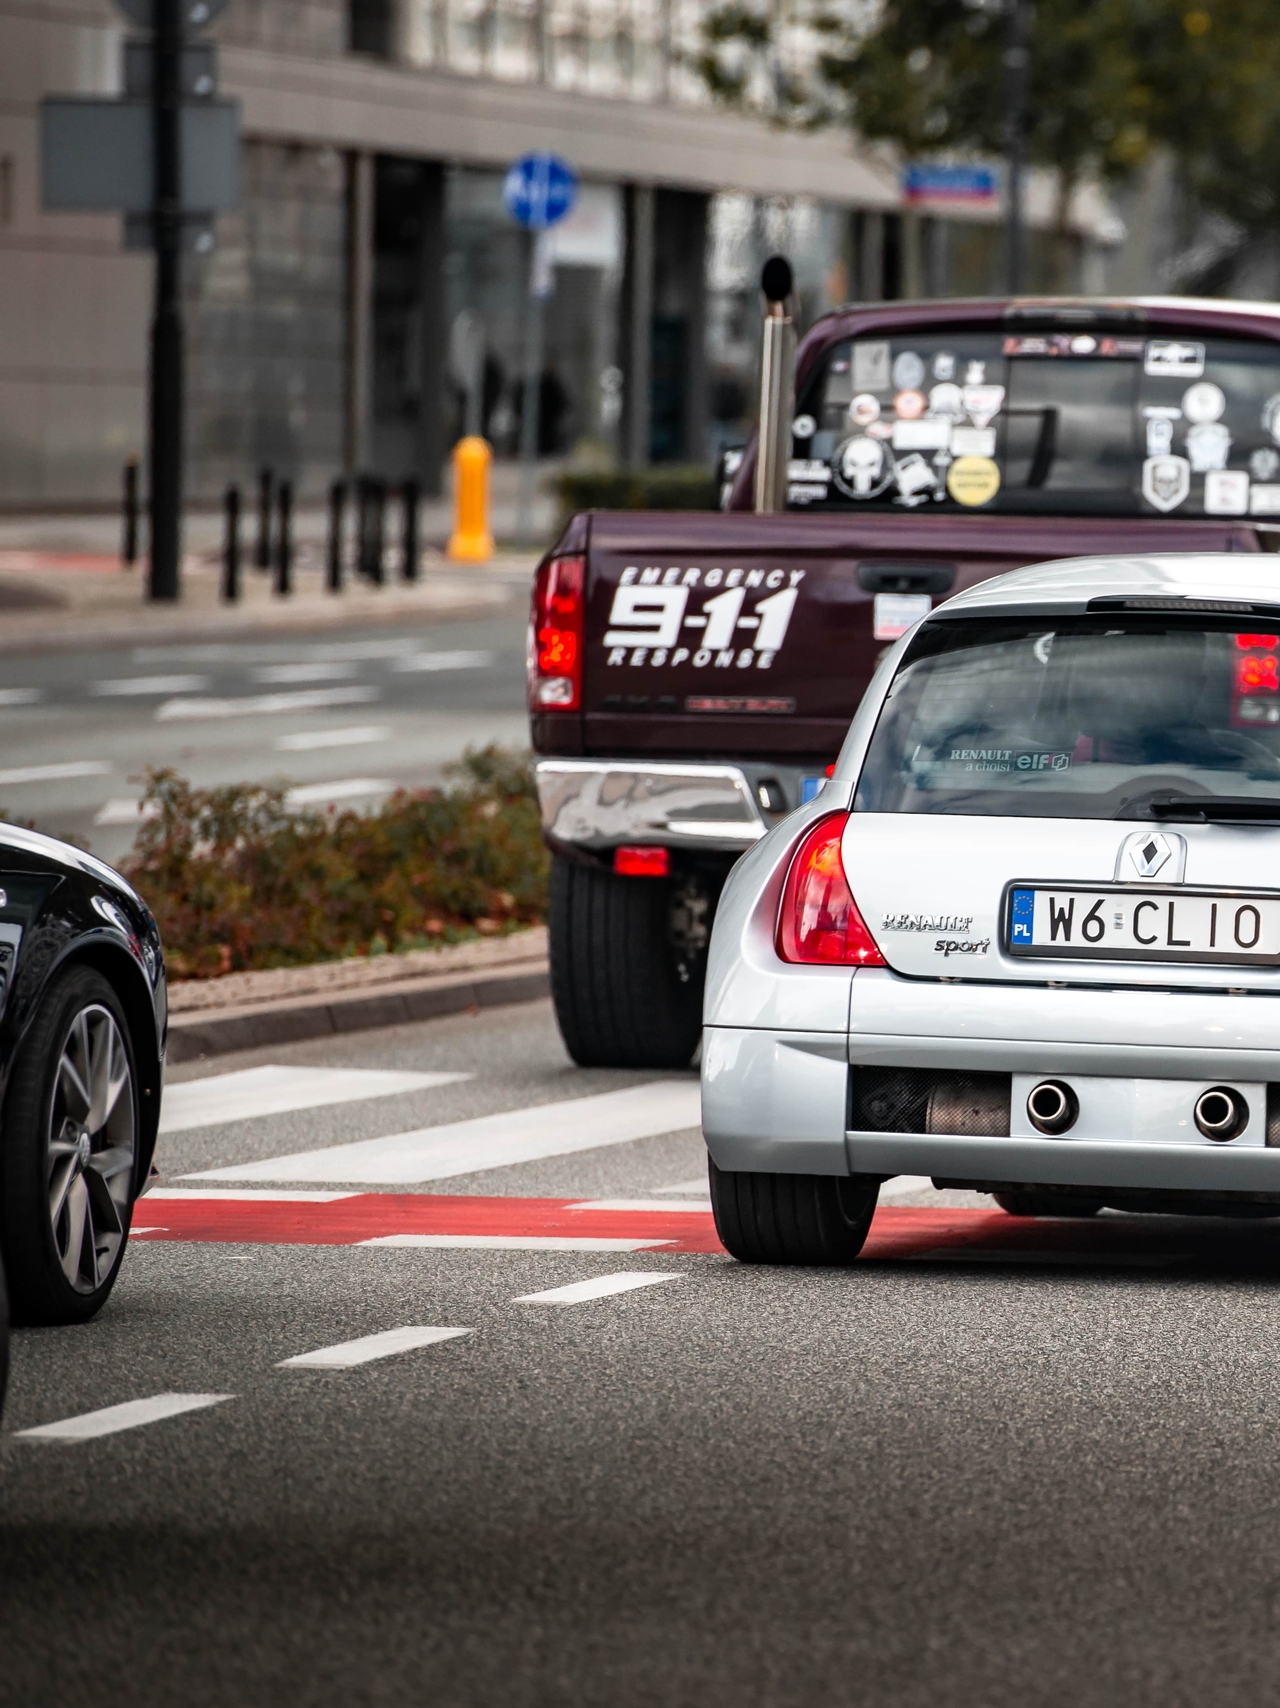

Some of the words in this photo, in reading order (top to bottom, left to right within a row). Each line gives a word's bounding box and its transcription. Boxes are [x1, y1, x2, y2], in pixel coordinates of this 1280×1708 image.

[620, 566, 806, 588] EMERGENCY
[603, 585, 799, 651] 9-1-1
[607, 647, 777, 669] RESPONSE
[950, 749, 1012, 760] RENAULT
[1016, 754, 1049, 769] elf
[965, 763, 973, 771] a
[975, 761, 1010, 772] choisi
[881, 913, 973, 934] RENAULT
[1014, 924, 1031, 938] PL
[1049, 897, 1106, 943] W6
[1133, 900, 1261, 949] CLIO
[934, 938, 990, 957] sport
